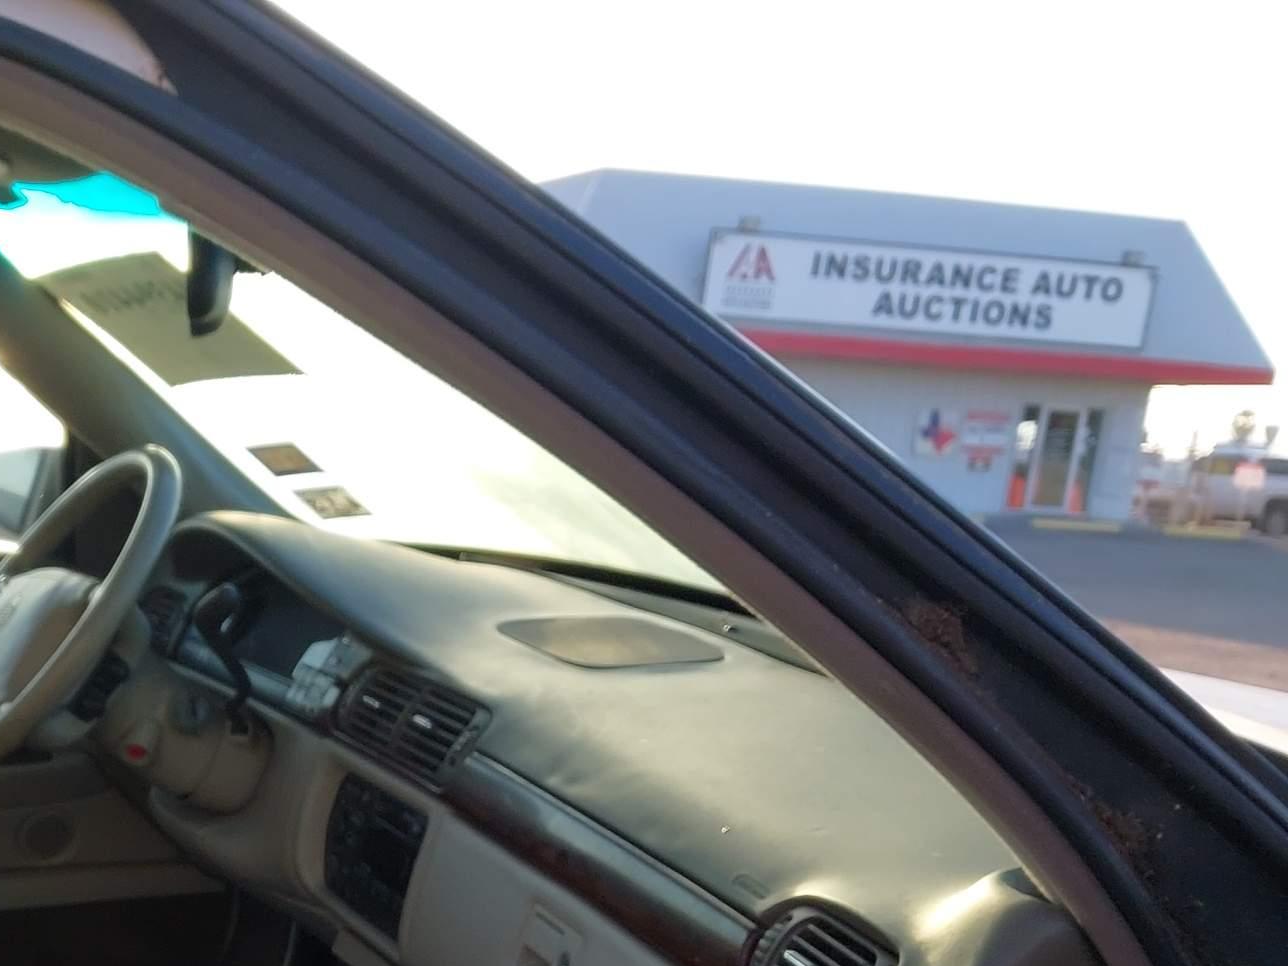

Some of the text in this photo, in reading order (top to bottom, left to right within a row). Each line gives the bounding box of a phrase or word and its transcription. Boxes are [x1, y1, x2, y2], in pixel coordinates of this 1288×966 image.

[810, 250, 1124, 303] INSURANCE AUTO
[872, 290, 1054, 330] AUCTIONS
